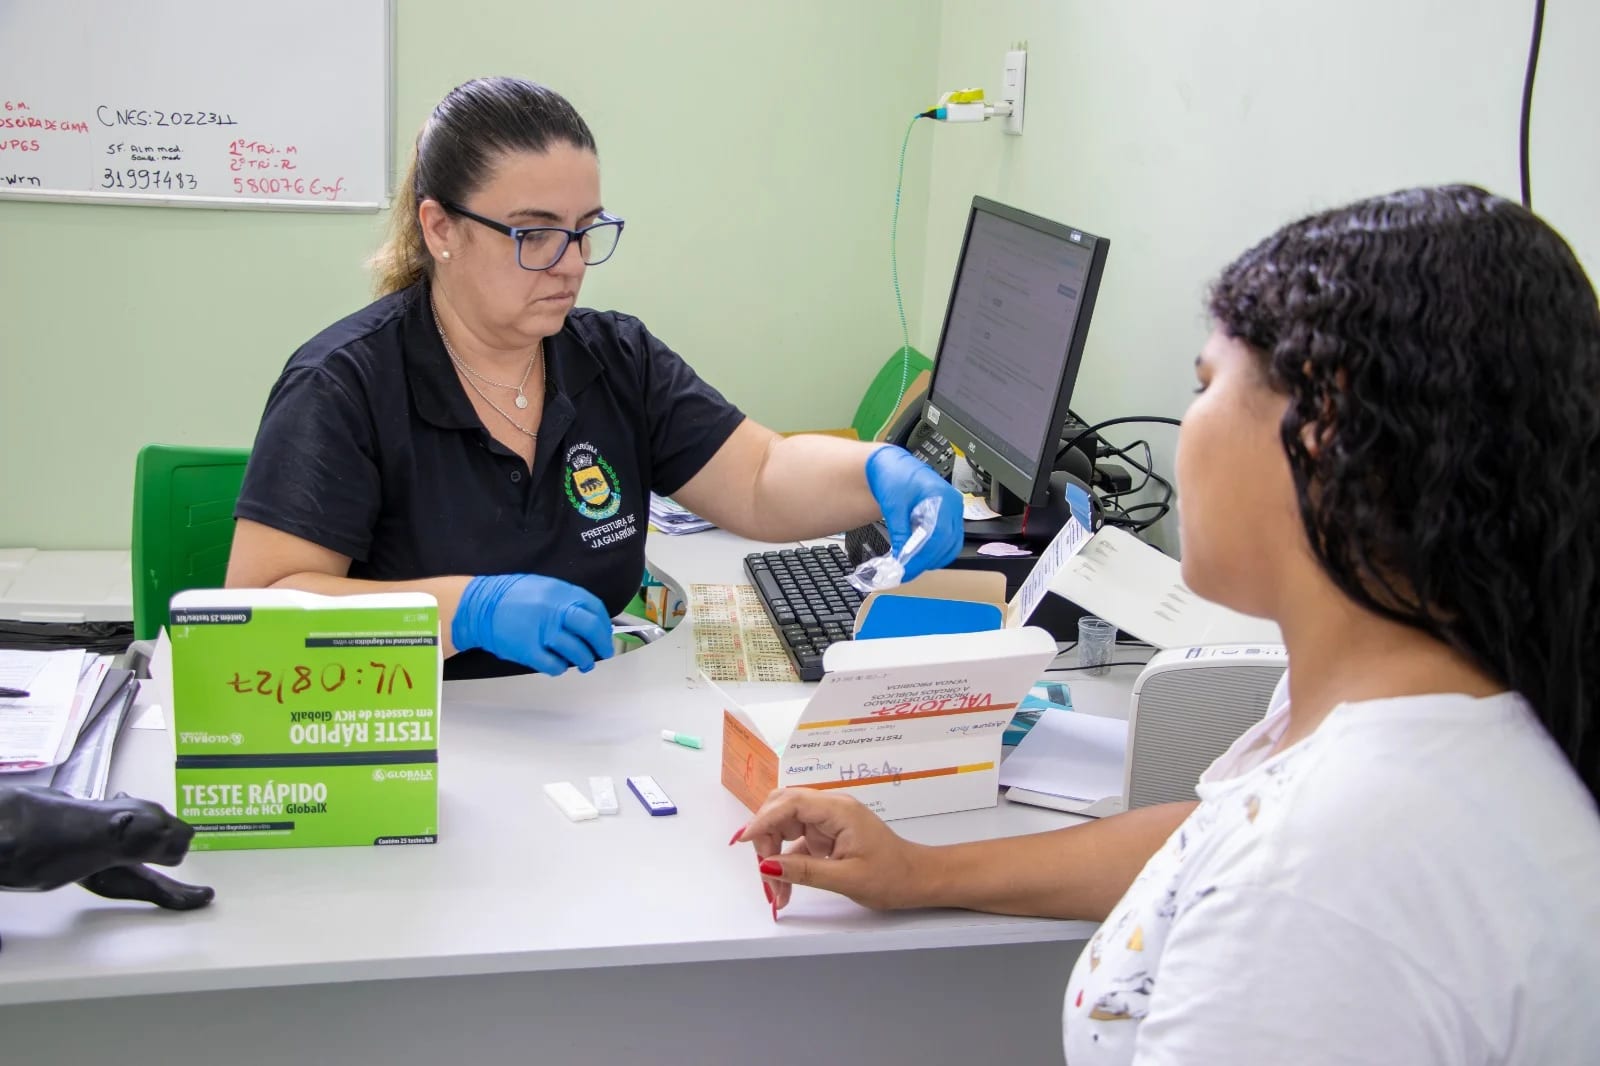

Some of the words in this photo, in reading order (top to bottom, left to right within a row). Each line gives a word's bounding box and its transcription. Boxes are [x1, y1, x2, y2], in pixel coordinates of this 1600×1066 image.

[580, 517, 628, 542] PREFEITURA
[627, 513, 636, 524] DE
[290, 711, 333, 722] GlobalX
[334, 711, 356, 722] HCV
[358, 710, 373, 721] de
[374, 708, 414, 719] cassete
[415, 708, 434, 718] em
[289, 722, 369, 747] RÁPIDO
[374, 720, 434, 742] TESTE
[181, 784, 243, 805] TESTE
[248, 780, 328, 804] RÁPIDO
[182, 807, 201, 817] em
[202, 805, 243, 816] cassete
[245, 804, 260, 816] de
[261, 804, 283, 815] HCV
[286, 803, 328, 814] GlobalX
